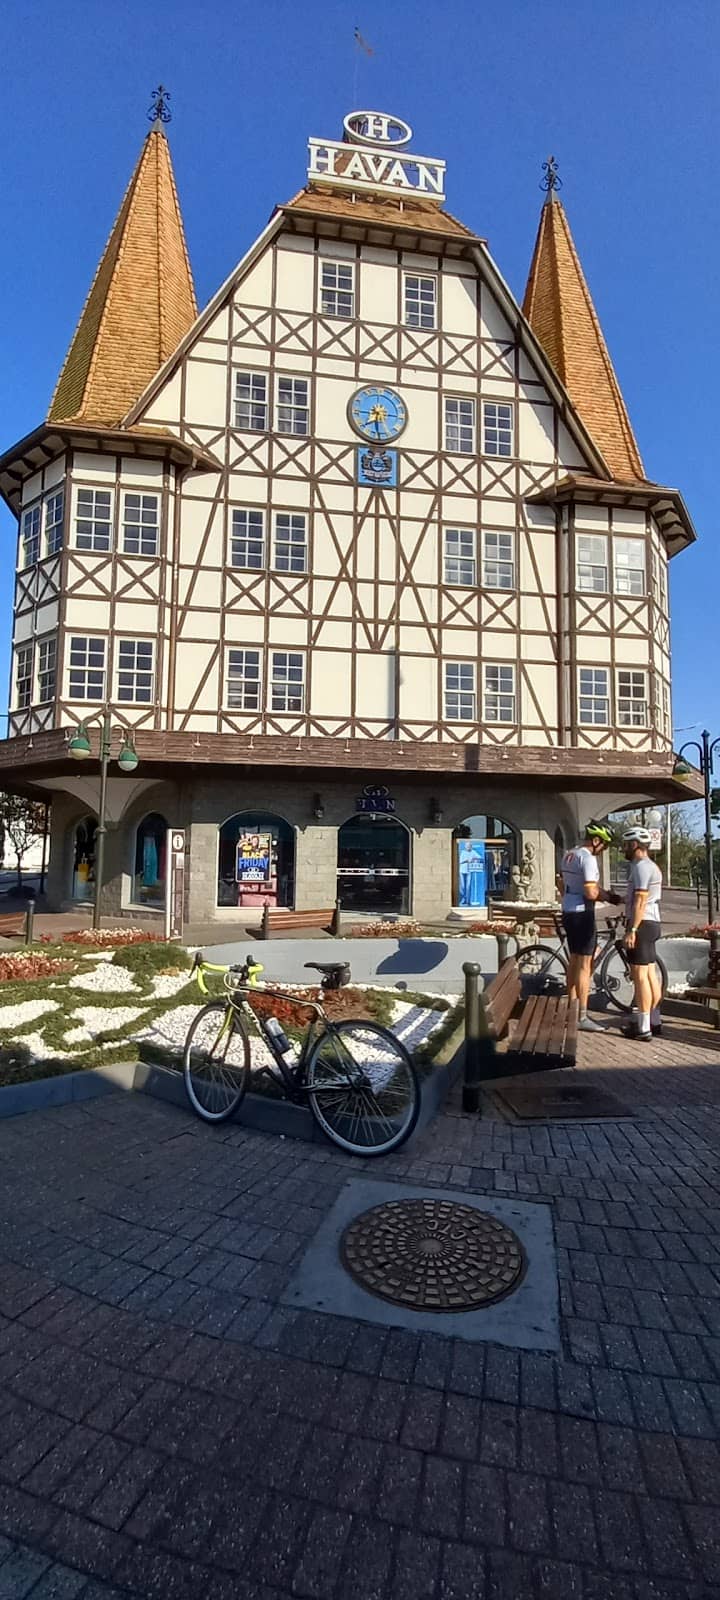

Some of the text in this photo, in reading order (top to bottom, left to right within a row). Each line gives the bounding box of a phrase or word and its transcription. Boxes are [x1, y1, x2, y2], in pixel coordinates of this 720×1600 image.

[365, 115, 391, 140] H
[307, 144, 447, 193] HAVAN
[239, 857, 269, 870] FRIDAY
